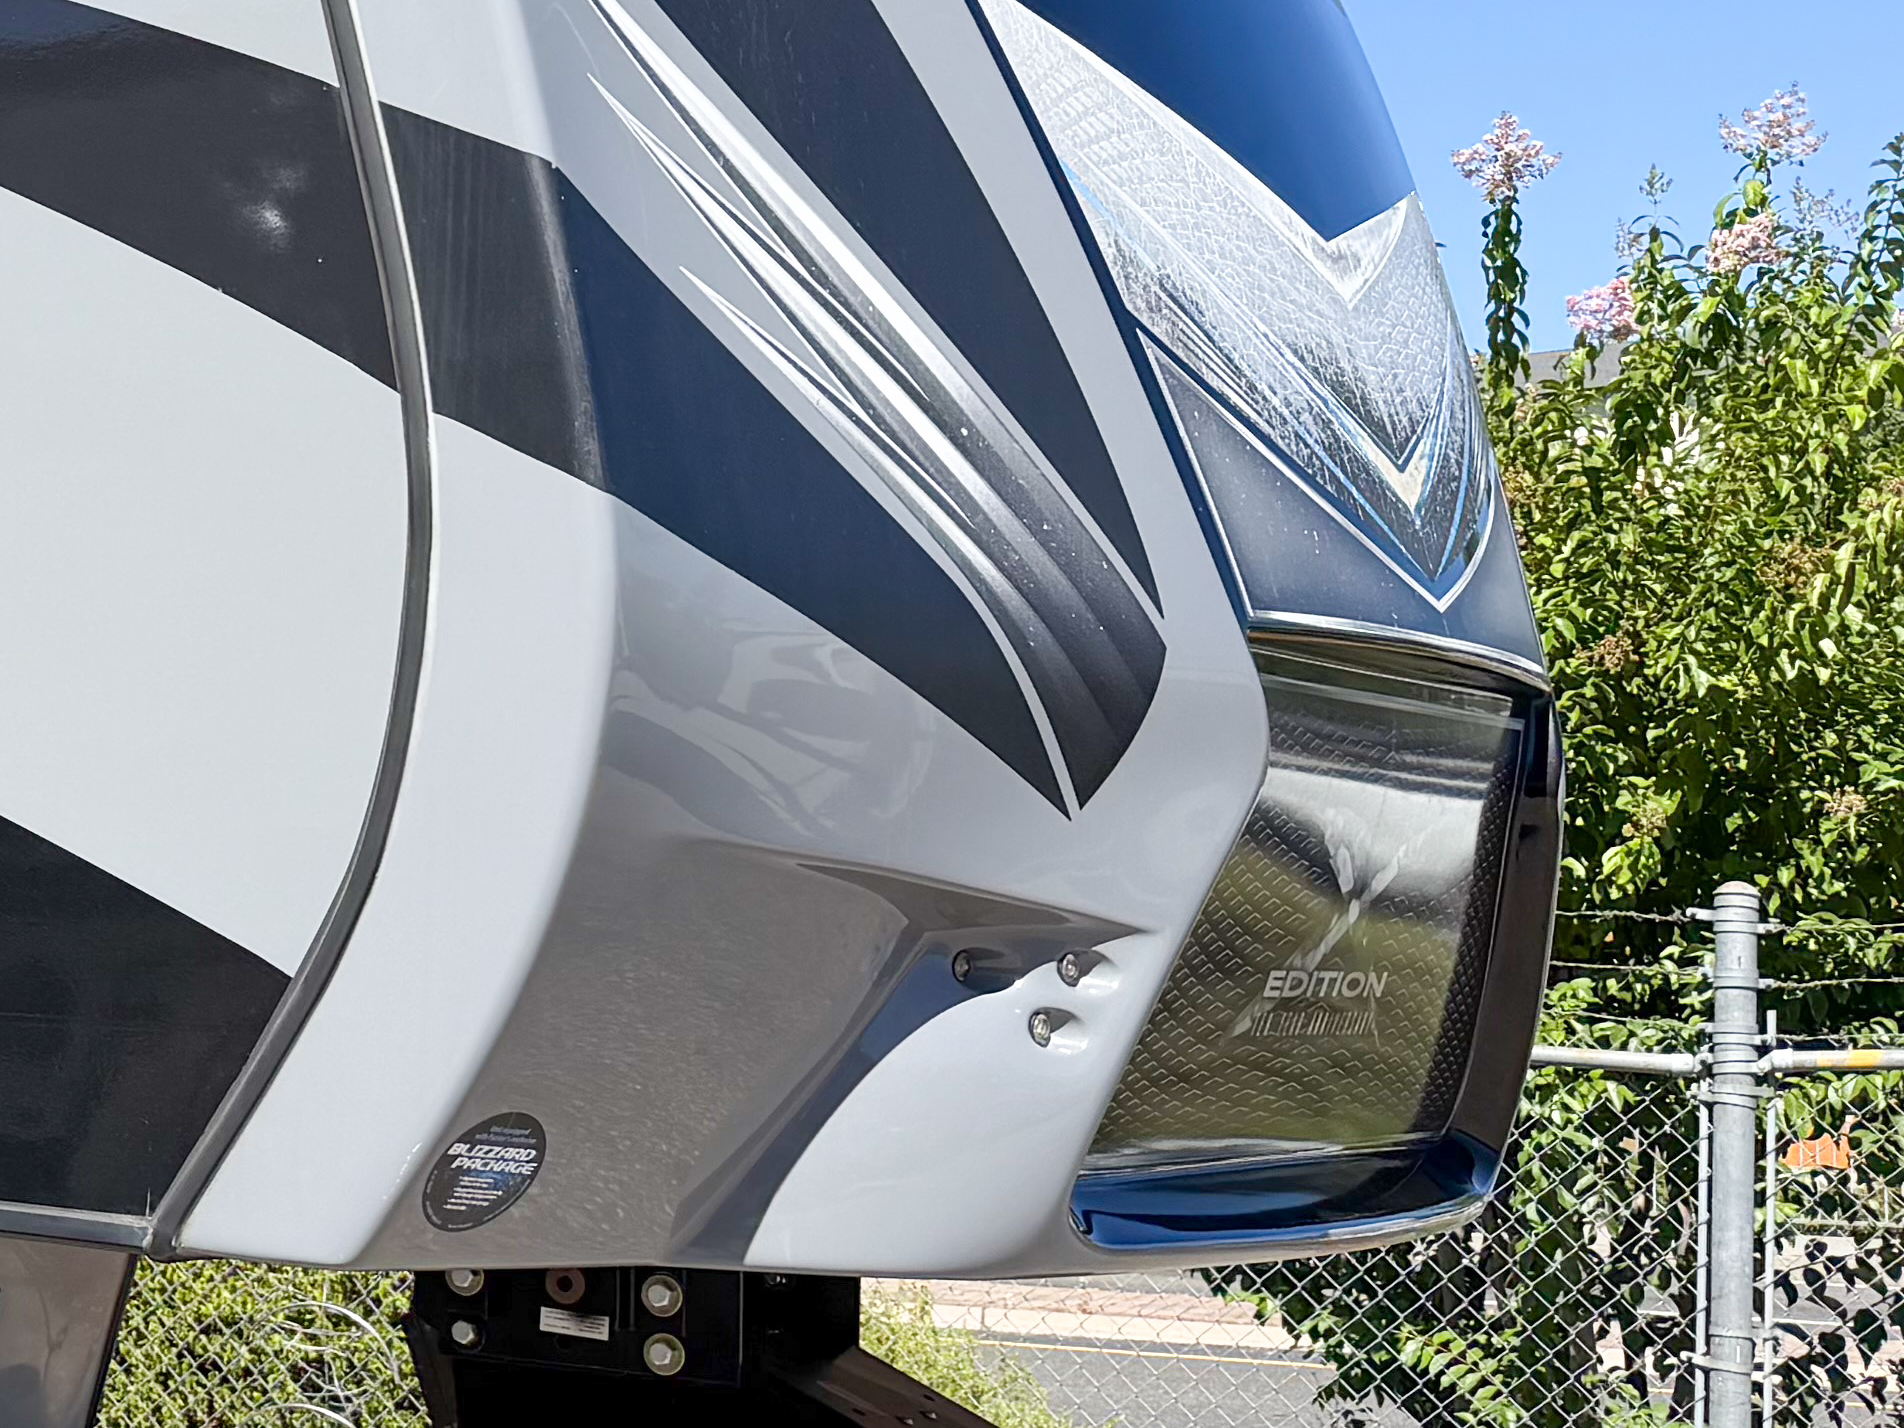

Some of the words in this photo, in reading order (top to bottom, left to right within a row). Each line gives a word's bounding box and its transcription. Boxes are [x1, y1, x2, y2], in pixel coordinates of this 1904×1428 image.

[1263, 970, 1389, 998] EDITION
[447, 1142, 537, 1161] BLIZZARD
[450, 1156, 539, 1175] PACKAGE
